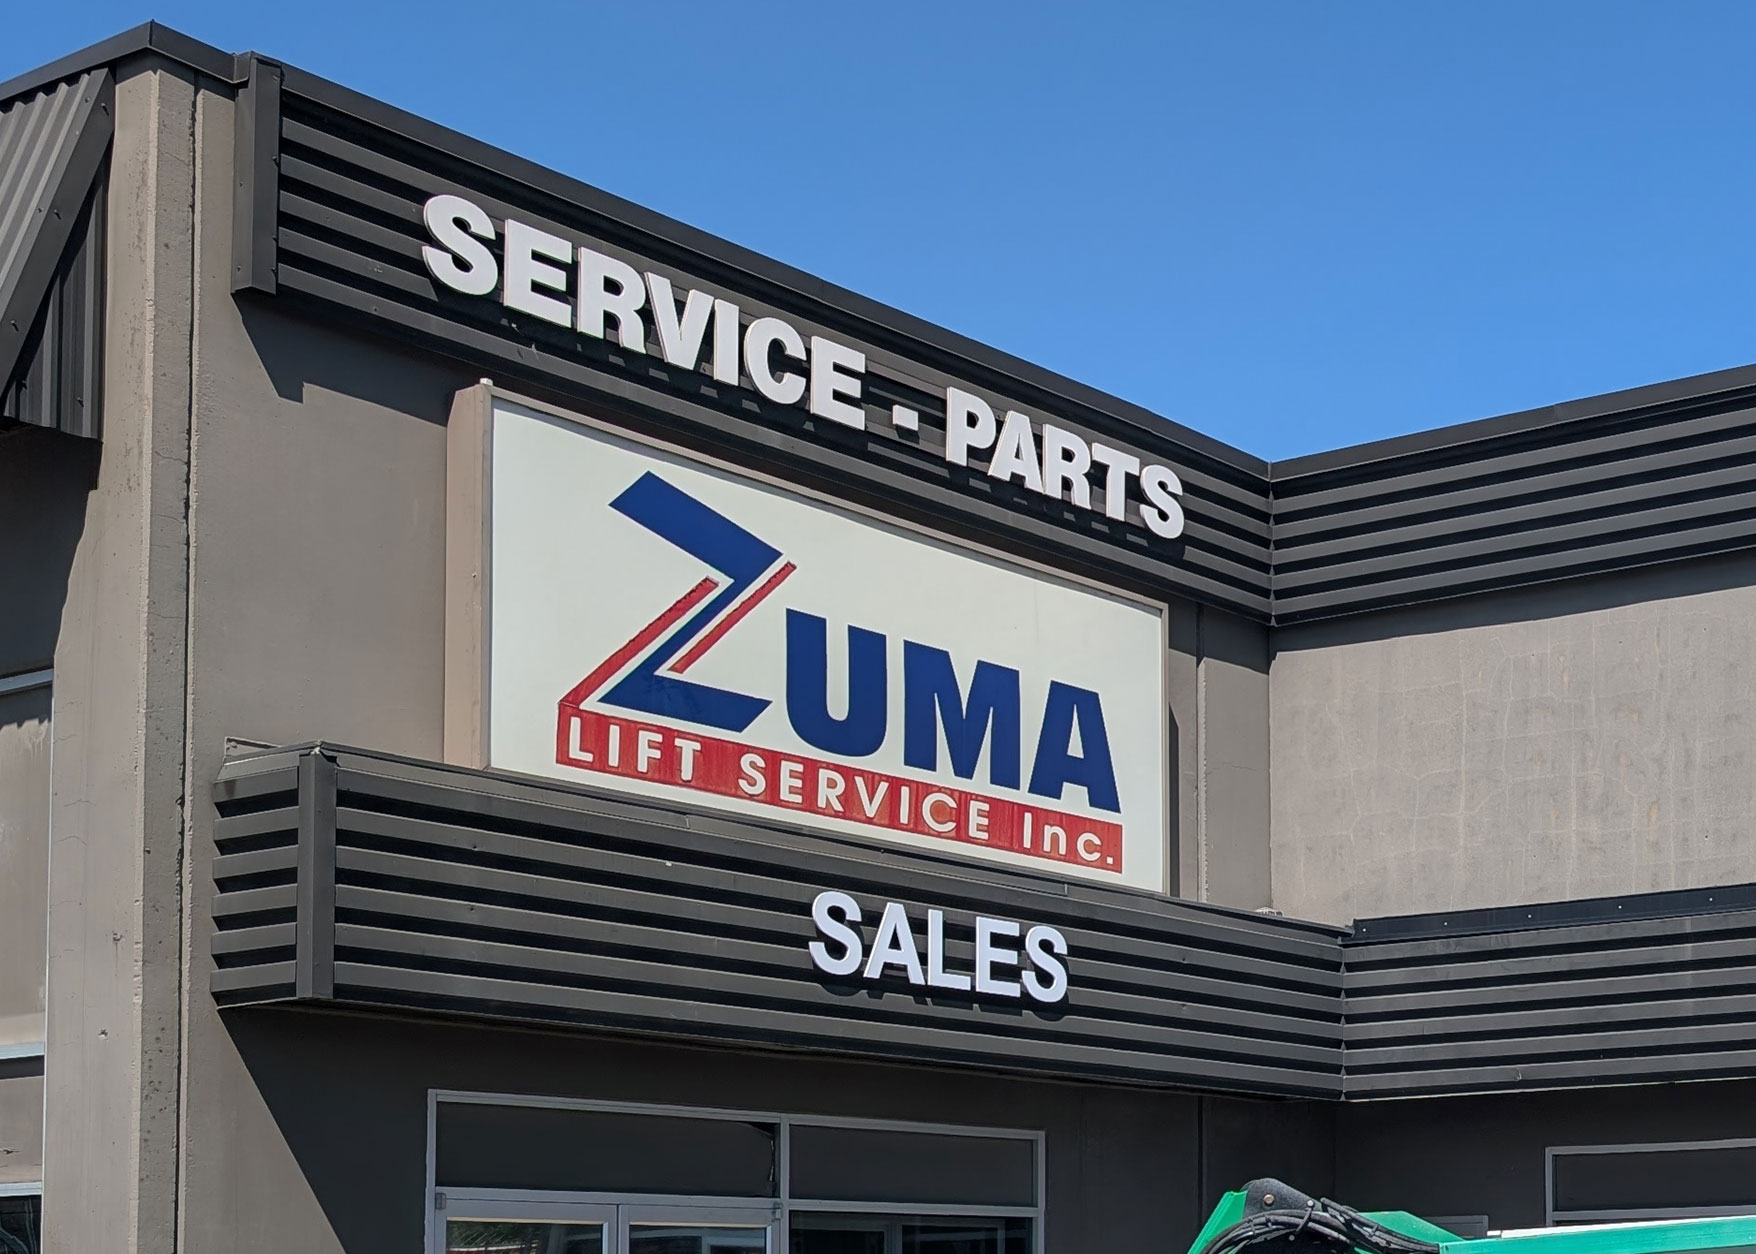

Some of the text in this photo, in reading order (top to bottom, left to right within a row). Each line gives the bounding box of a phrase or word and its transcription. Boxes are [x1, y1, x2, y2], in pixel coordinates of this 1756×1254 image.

[422, 194, 866, 430] SERVICE
[945, 386, 1185, 540] PARTS
[558, 470, 1122, 814] ZUMA
[567, 716, 1116, 867] LIFT SERVICE Inc.
[808, 890, 1068, 1004] SALES
